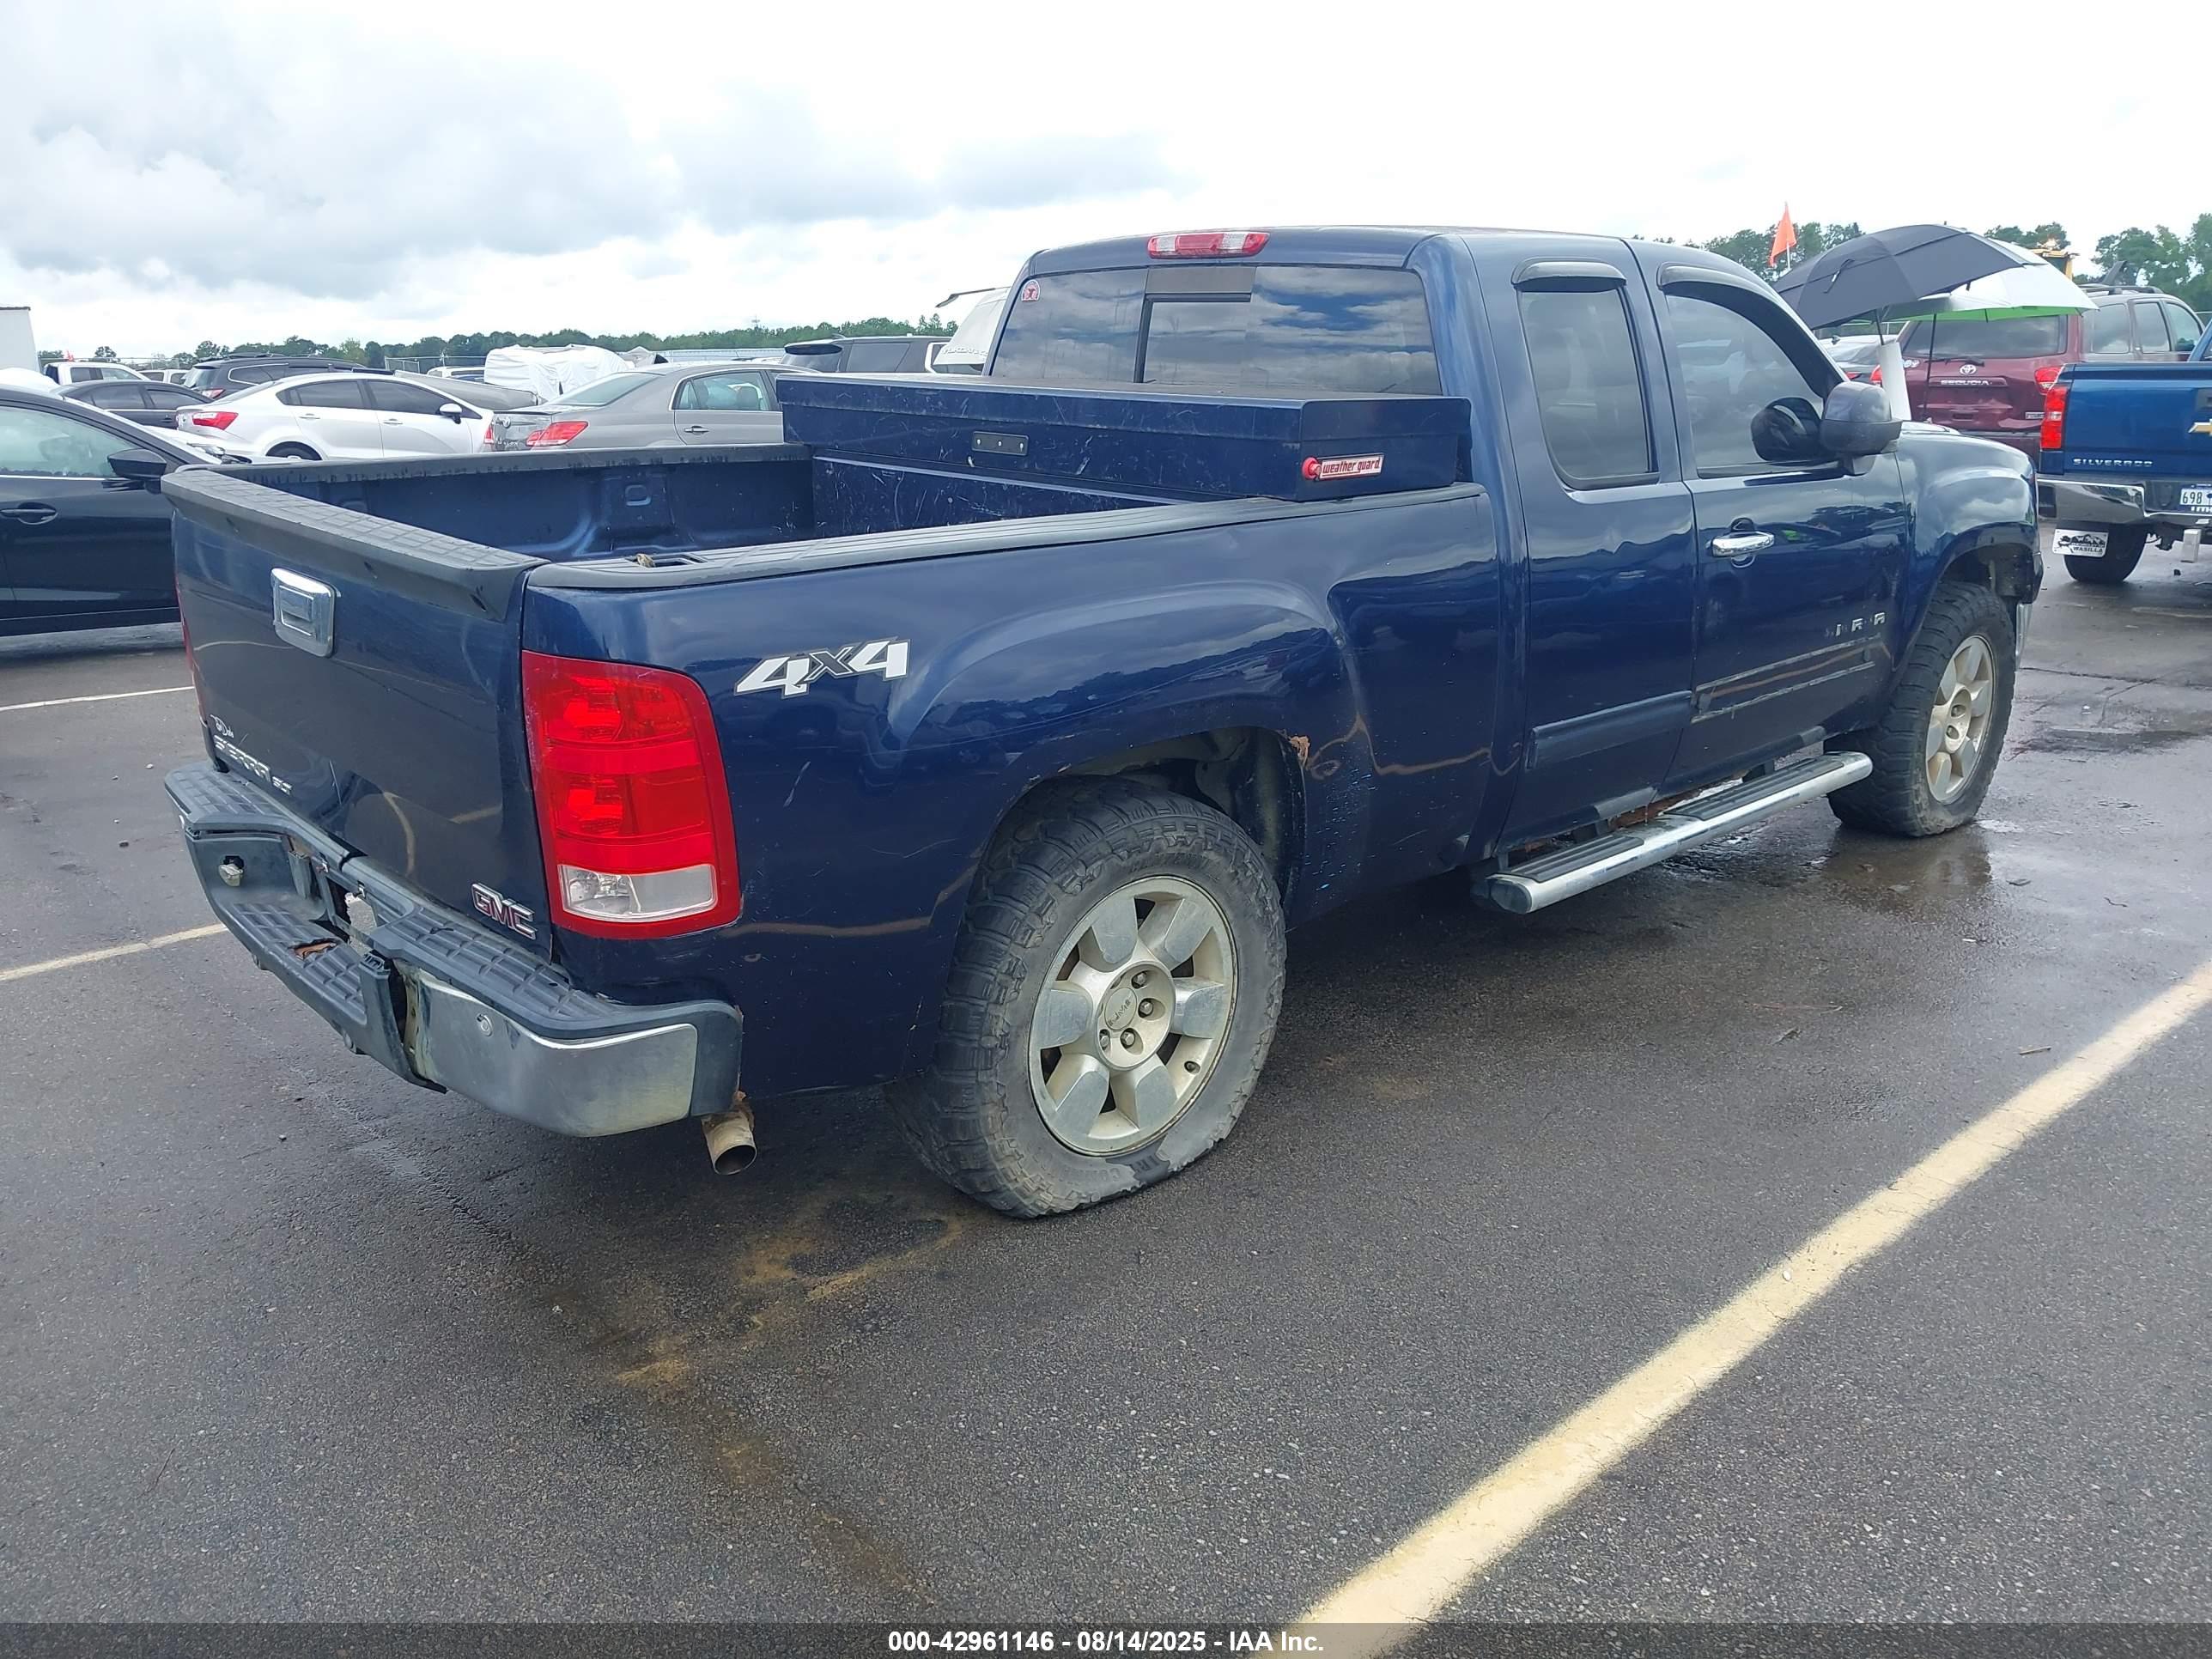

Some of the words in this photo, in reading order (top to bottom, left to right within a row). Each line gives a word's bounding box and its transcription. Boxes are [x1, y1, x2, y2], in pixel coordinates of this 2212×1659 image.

[1322, 461, 1356, 474] weather
[1357, 457, 1381, 473] guard
[2073, 458, 2154, 467] SILVERADO
[2182, 491, 2203, 505] 698
[471, 883, 538, 940] GMC
